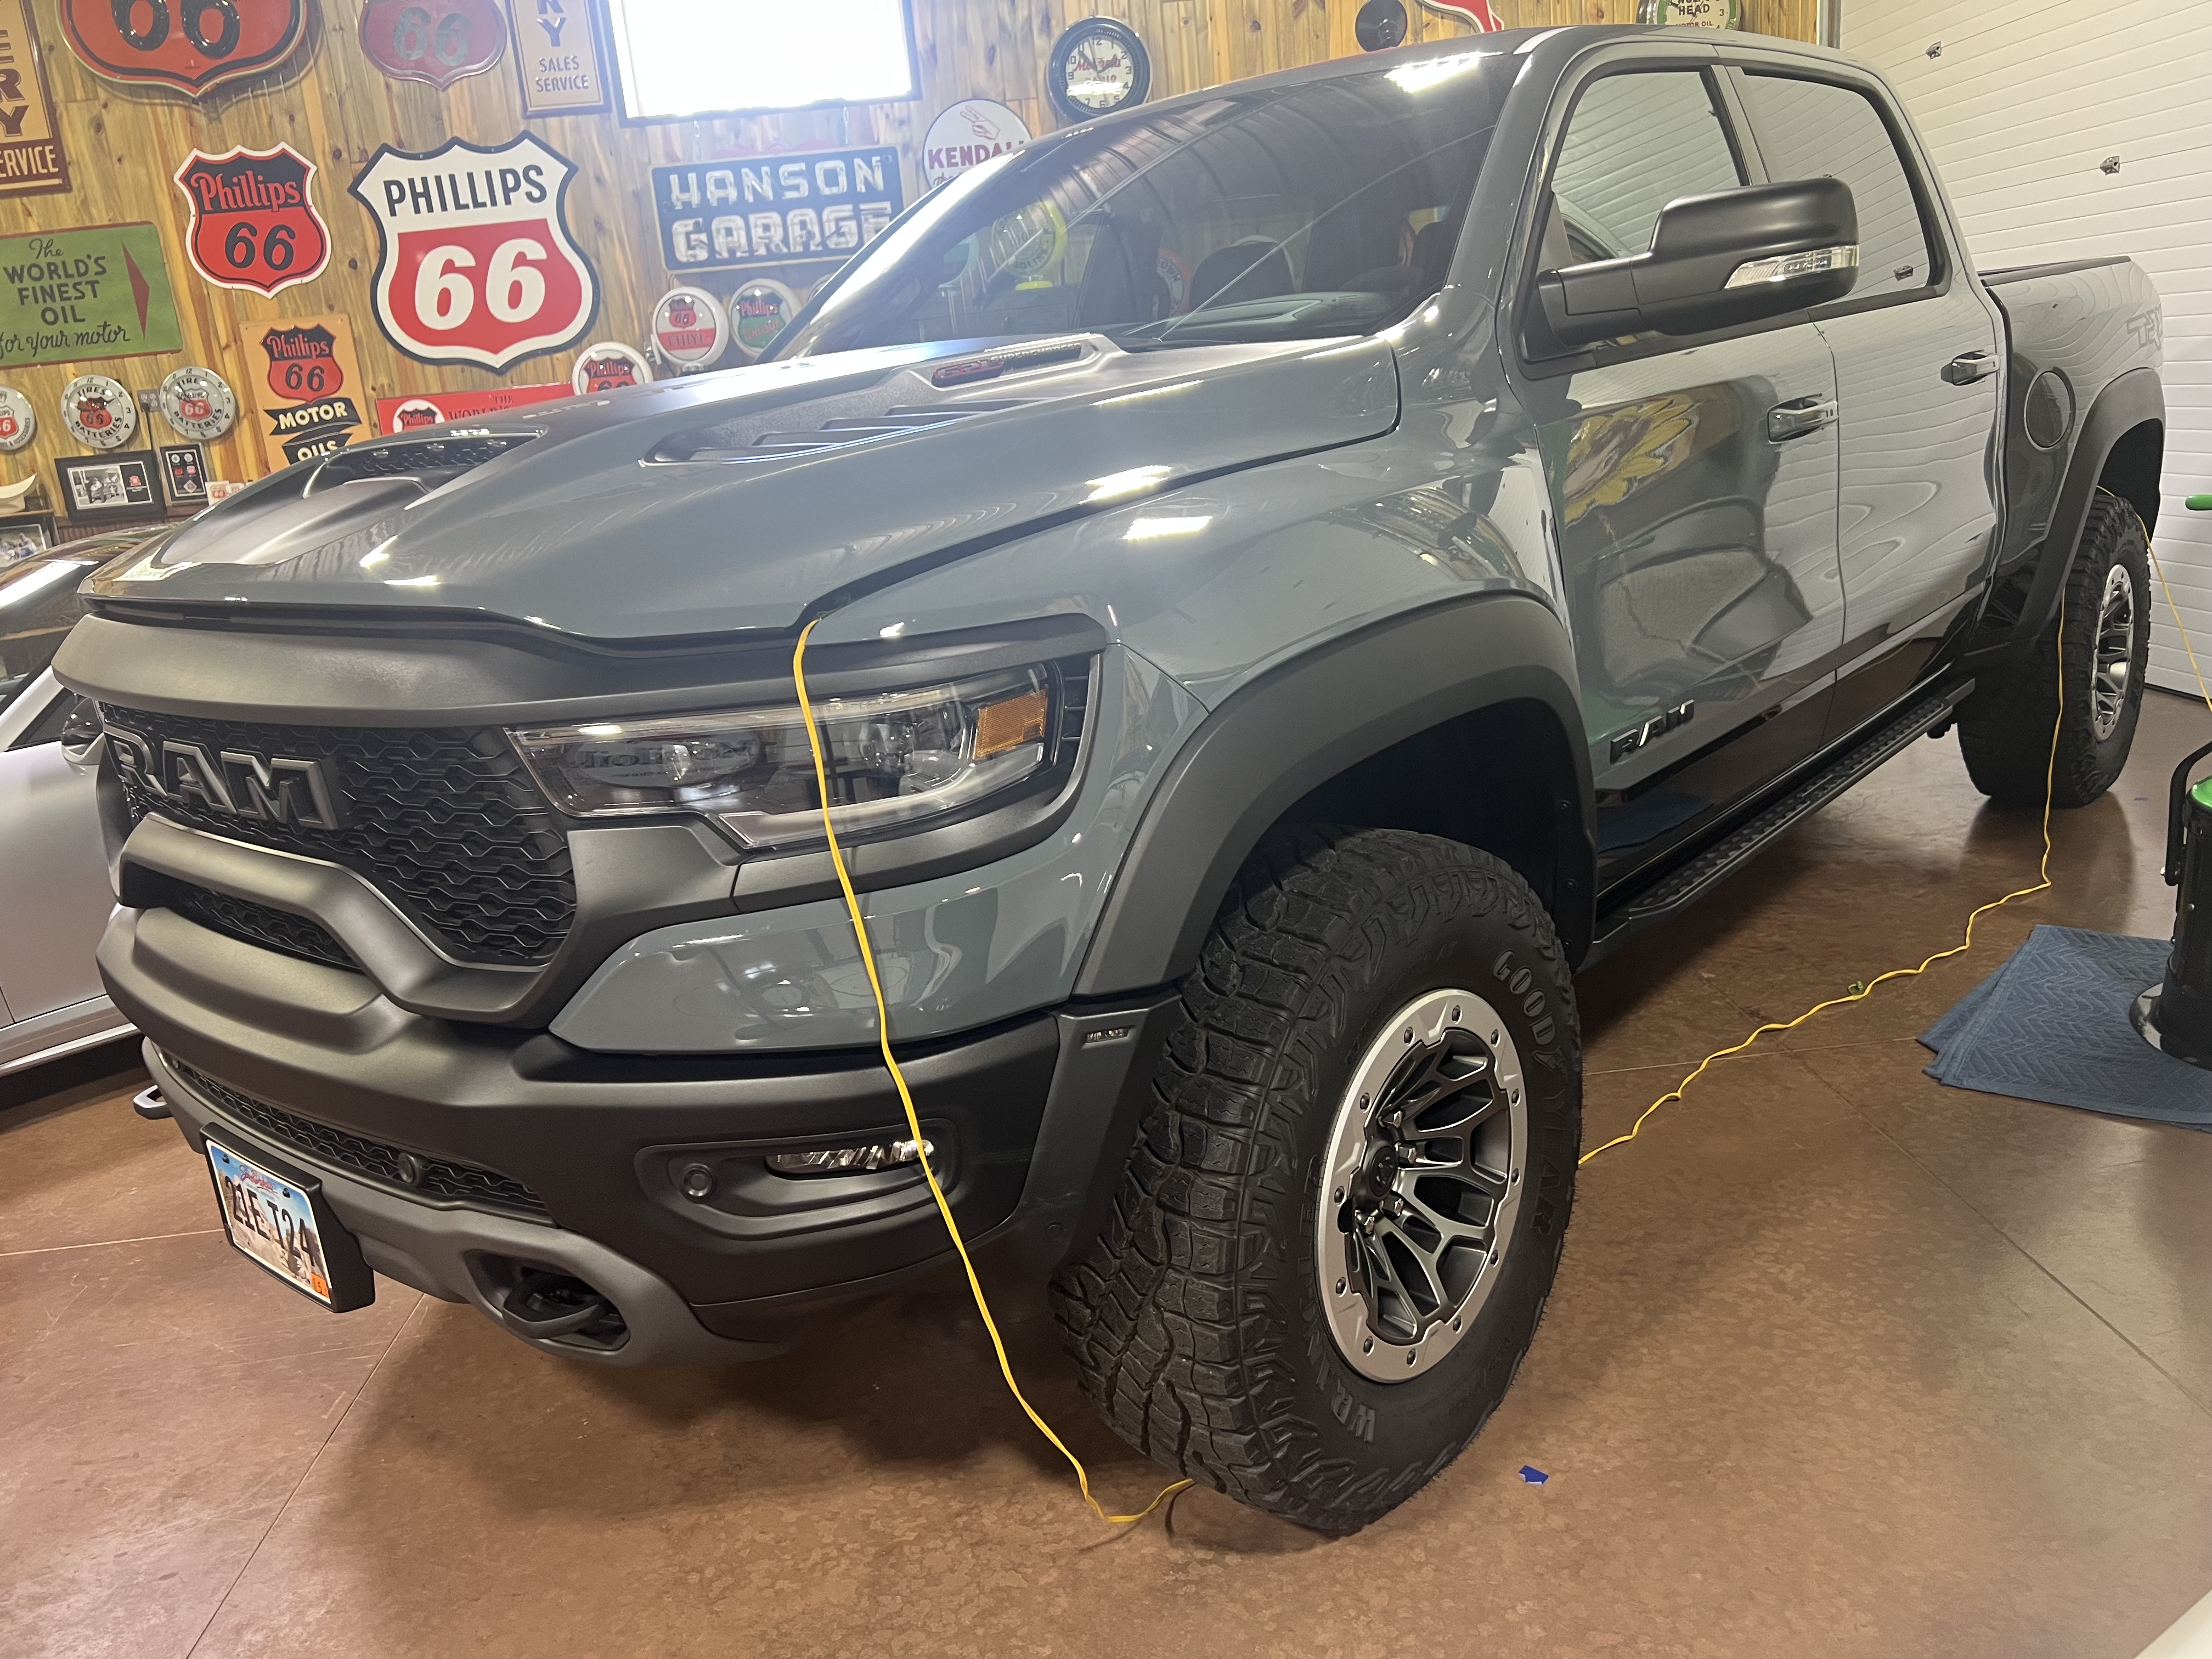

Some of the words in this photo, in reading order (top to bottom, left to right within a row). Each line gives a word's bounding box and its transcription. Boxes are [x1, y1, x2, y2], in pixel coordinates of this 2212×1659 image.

[1679, 4, 1710, 15] HEAD
[393, 7, 472, 66] 66
[539, 55, 580, 72] SALES
[535, 75, 589, 93] SERVICE
[928, 140, 1025, 170] KENDA
[190, 170, 301, 213] Phillips
[383, 164, 548, 217] PHILLIPS
[669, 156, 884, 210] HANSON
[670, 201, 893, 263] GARAGE
[29, 238, 64, 259] The
[224, 222, 296, 271] 66
[3, 253, 107, 284] WORLD'S
[18, 279, 100, 306] FINEST
[414, 238, 548, 331] 66
[41, 304, 86, 326] OIL
[26, 330, 71, 358] your
[75, 320, 131, 347] motor
[266, 334, 330, 360] Phillips
[176, 377, 207, 386] TIRE
[285, 363, 325, 393] 66
[587, 360, 630, 378] Phillips
[77, 387, 107, 397] TIRES
[494, 394, 514, 404] THE
[75, 416, 122, 438] BATTERIES
[174, 408, 222, 429] BATTERIES
[278, 401, 348, 431] MOTOR
[402, 411, 434, 426] Phillips
[297, 440, 338, 461] OILS
[1610, 699, 1695, 765] RAM
[103, 723, 338, 831] RAM
